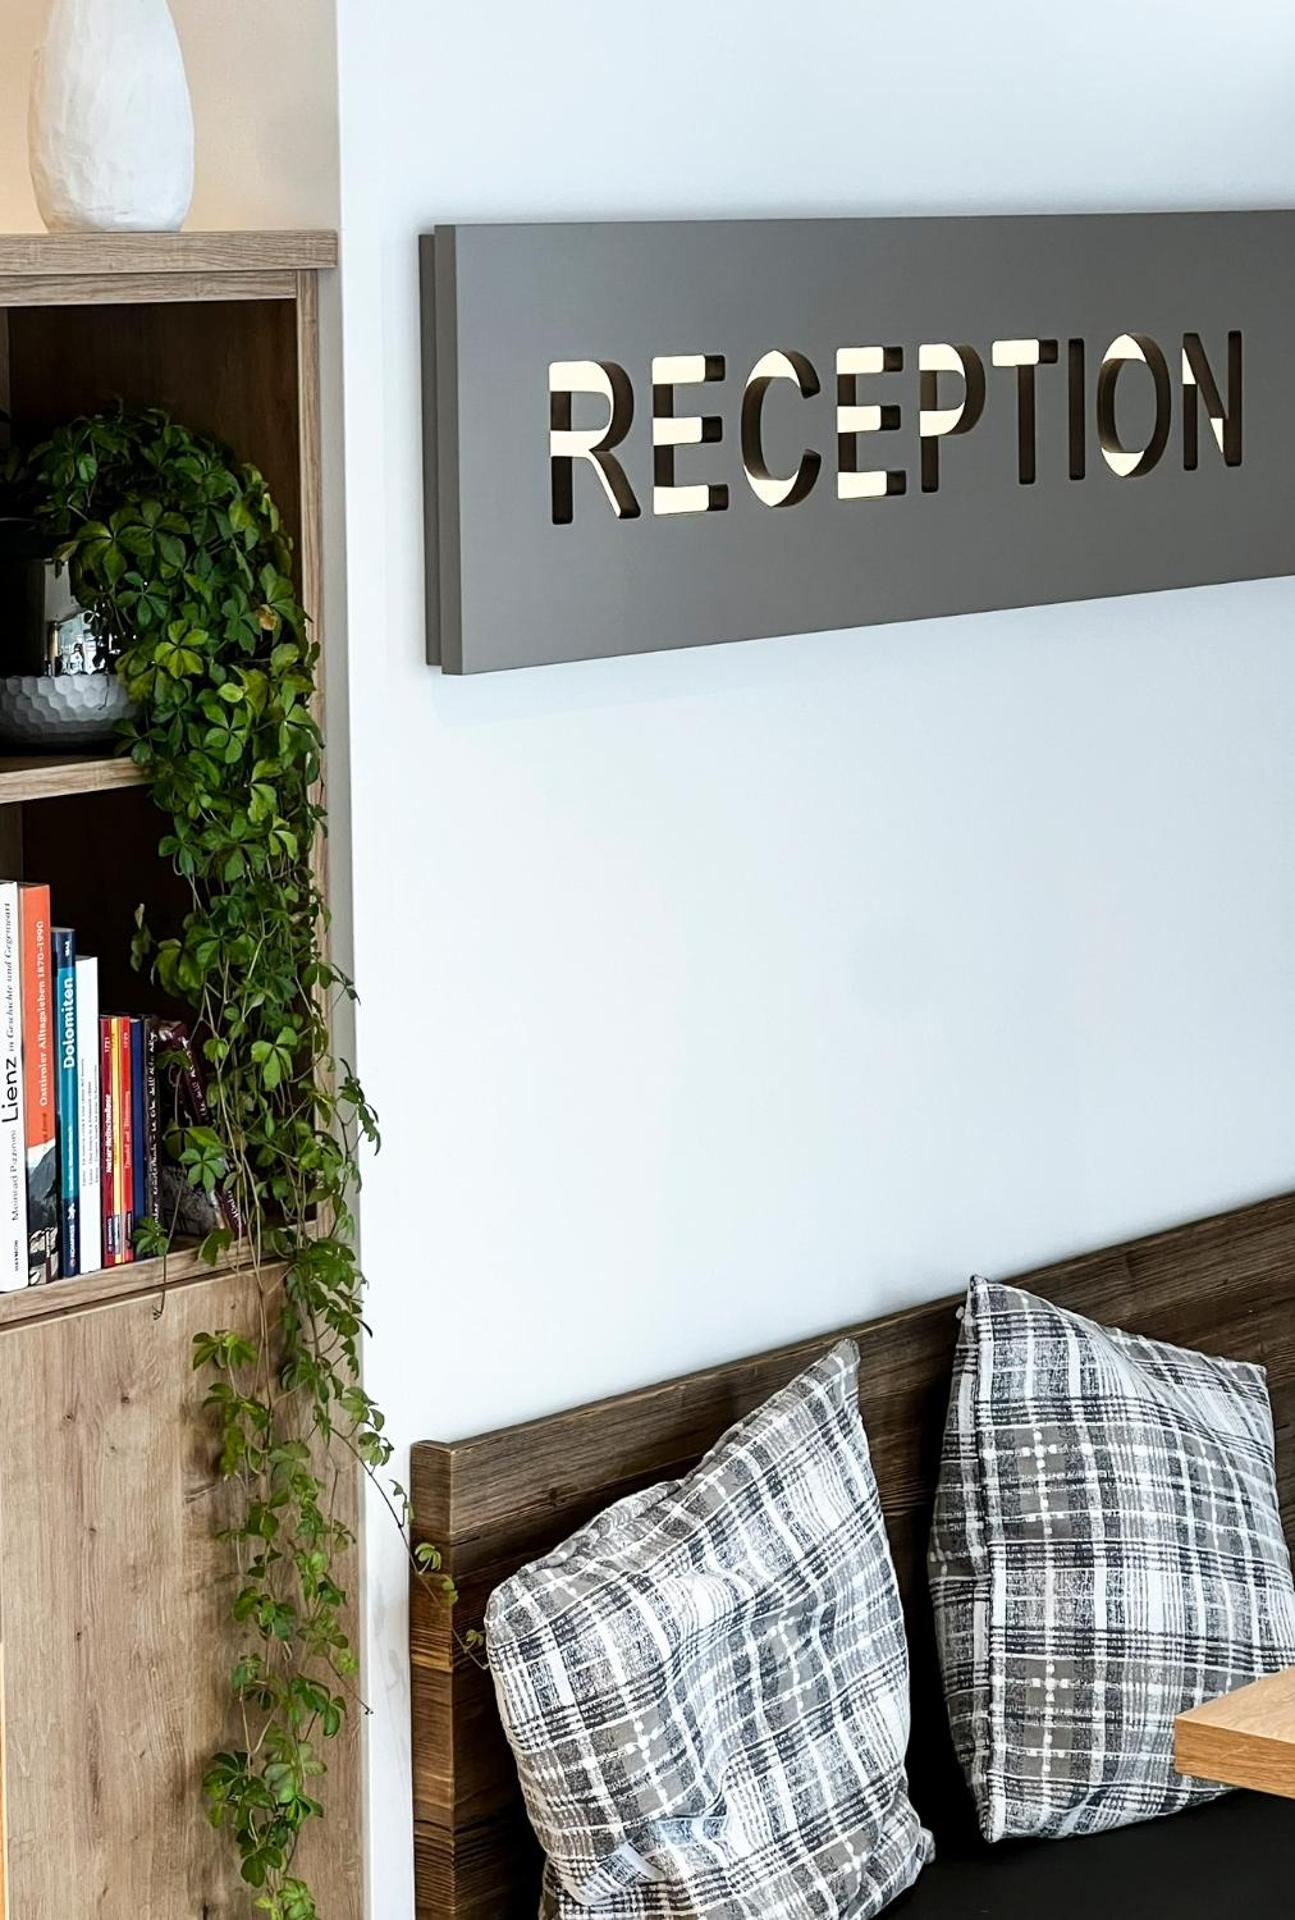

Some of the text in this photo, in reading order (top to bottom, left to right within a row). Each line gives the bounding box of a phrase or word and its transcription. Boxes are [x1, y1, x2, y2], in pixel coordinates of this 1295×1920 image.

[548, 329, 1243, 525] RECEPTION
[3, 902, 12, 958] Gegenwart
[5, 959, 14, 983] und
[5, 985, 15, 1040] Geschichte
[37, 979, 48, 1050] Alltagsleben
[61, 976, 75, 1069] Dolomiten
[1, 1057, 19, 1123] Lienz
[38, 1053, 48, 1107] Osttiroler
[10, 1174, 19, 1221] Meinrad
